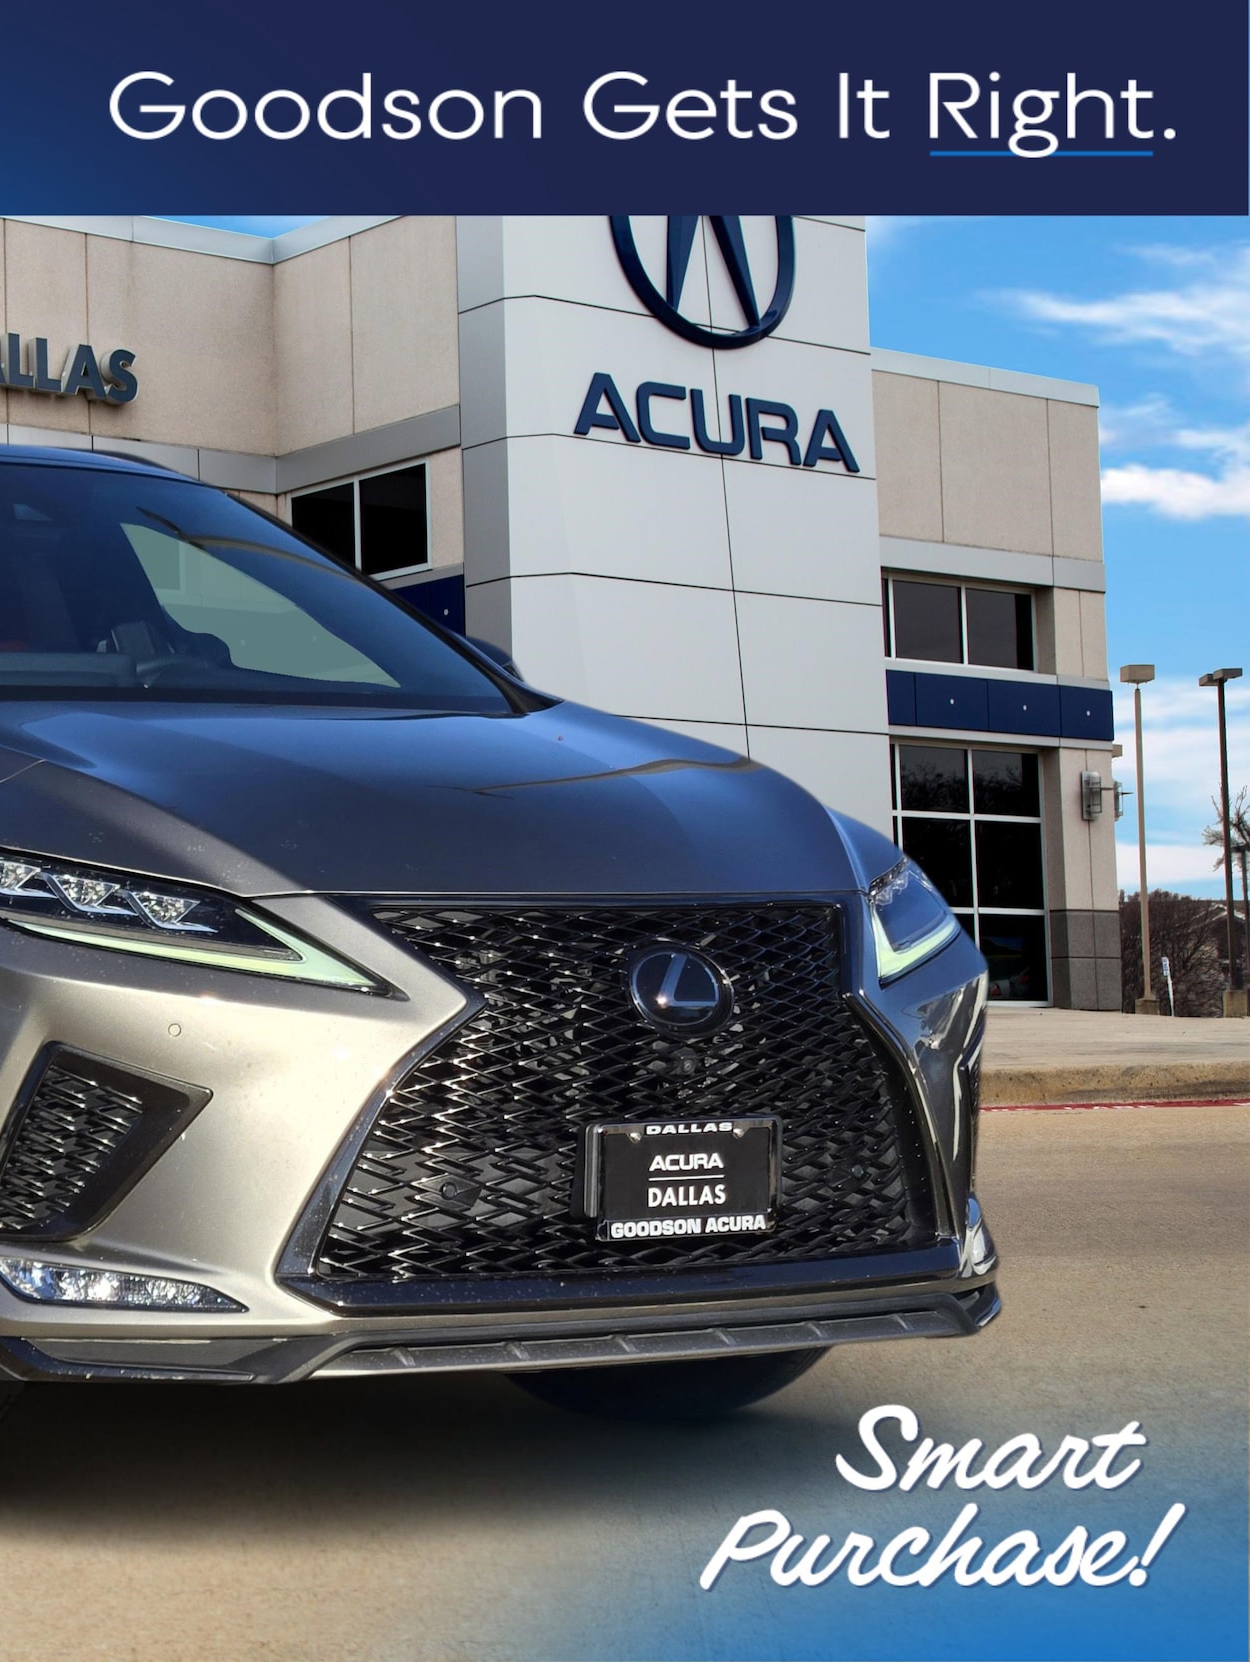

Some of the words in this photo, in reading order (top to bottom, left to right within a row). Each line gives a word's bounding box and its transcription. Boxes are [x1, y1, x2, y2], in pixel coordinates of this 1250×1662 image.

[572, 370, 860, 473] ACURA
[646, 1121, 733, 1135] DALLAS
[649, 1152, 724, 1172] ACURA
[647, 1184, 727, 1208] DALLAS
[610, 1218, 701, 1239] GOODSON
[705, 1214, 767, 1234] ACURA
